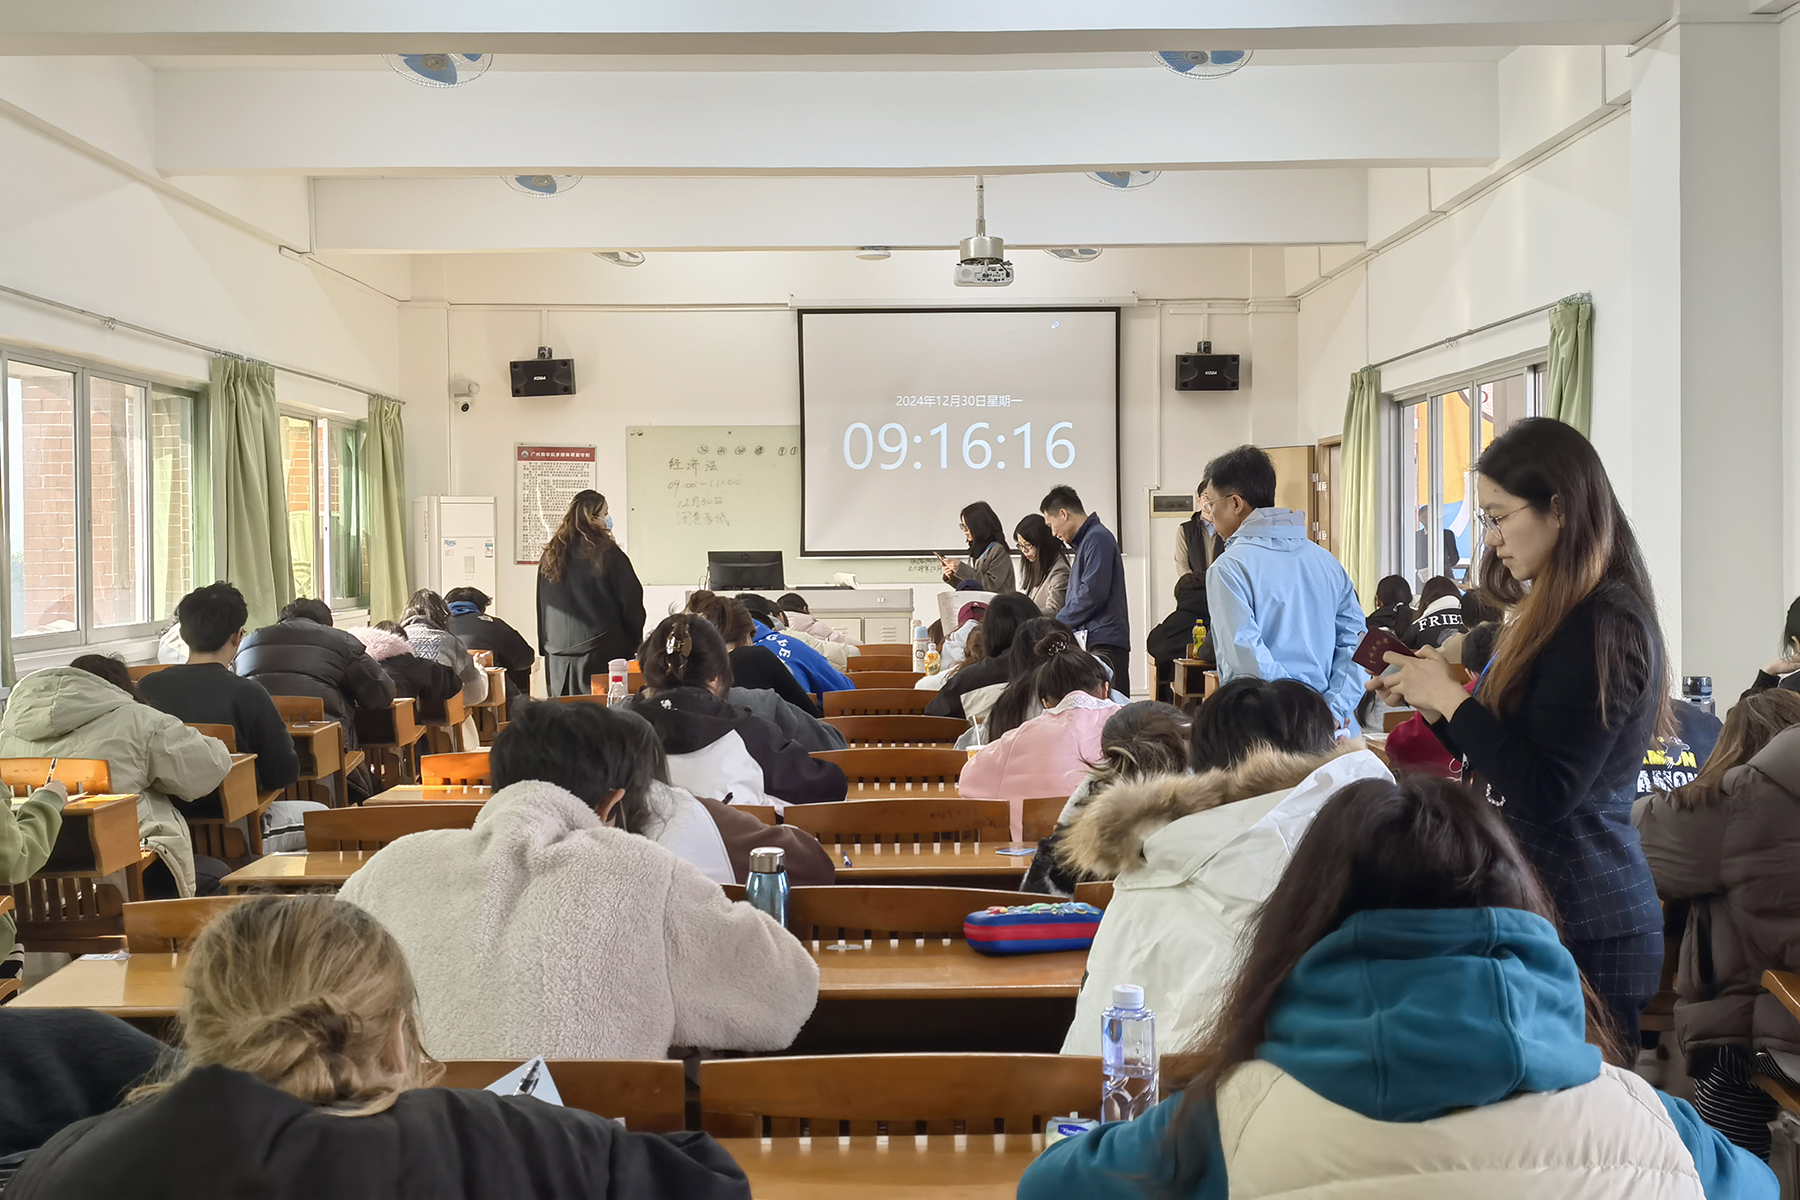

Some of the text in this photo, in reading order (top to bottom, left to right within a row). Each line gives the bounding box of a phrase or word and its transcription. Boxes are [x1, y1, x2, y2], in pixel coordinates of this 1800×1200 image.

[896, 394, 1023, 408] 2024年12月30日星期一
[843, 421, 1076, 470] 09:16:16
